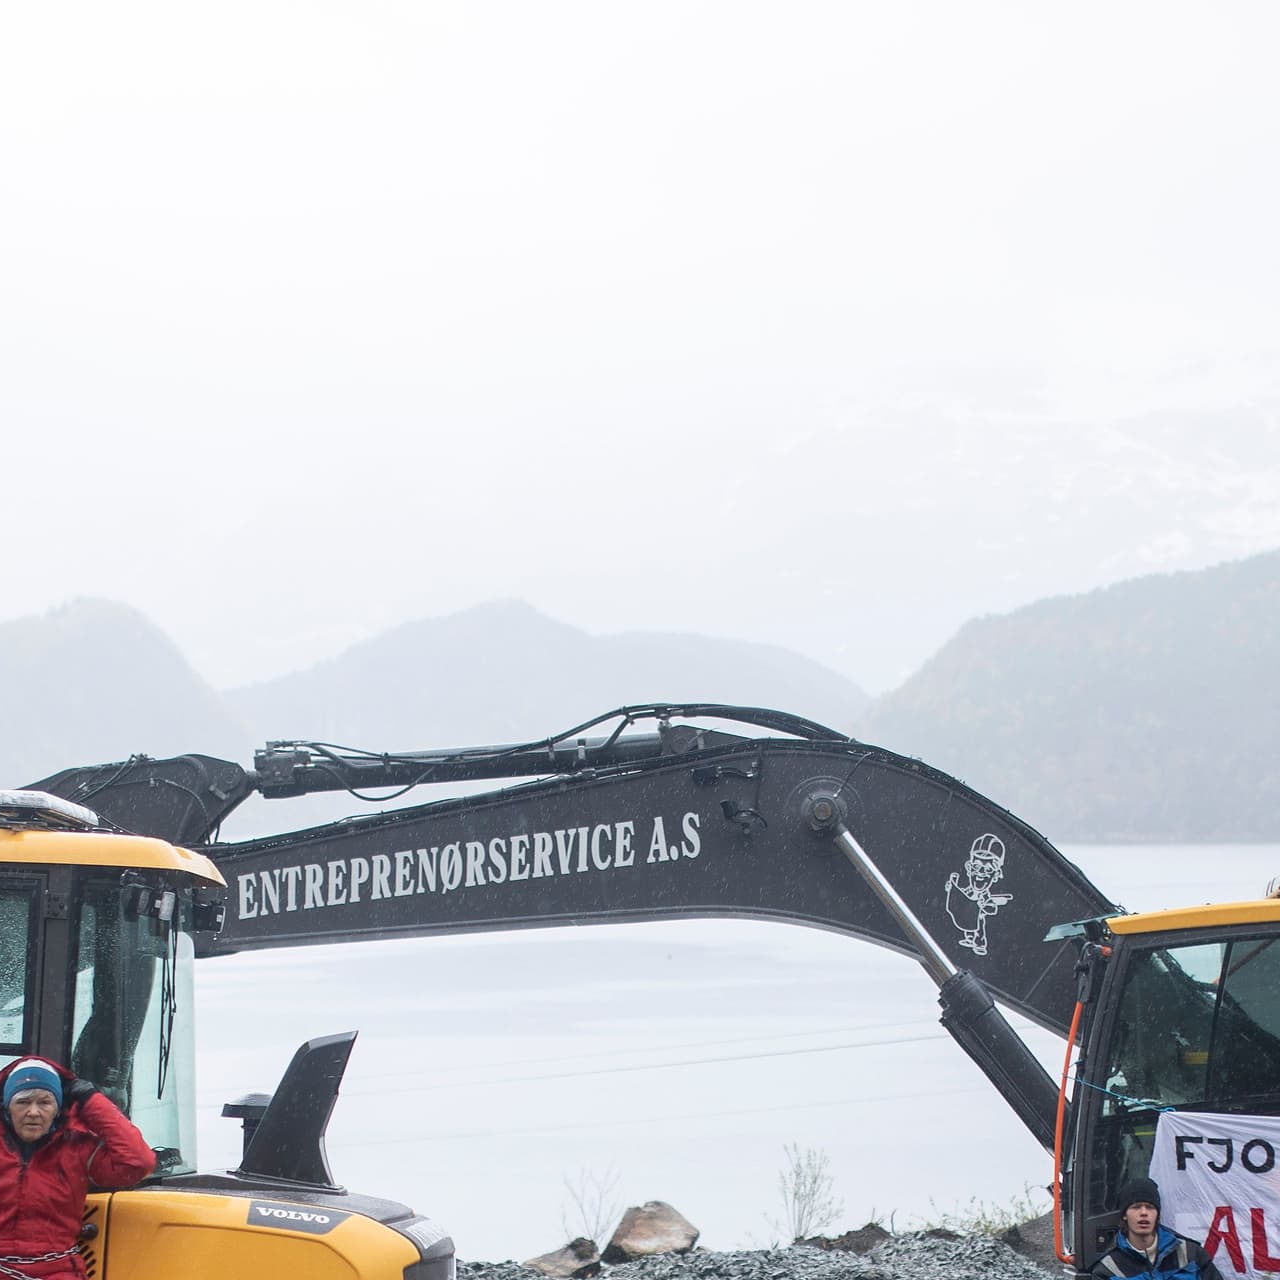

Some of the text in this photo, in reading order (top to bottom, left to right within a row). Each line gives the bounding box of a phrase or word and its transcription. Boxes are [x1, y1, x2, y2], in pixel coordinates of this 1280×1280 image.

[237, 811, 702, 920] ENTREPRENØRSERVICE A.S
[255, 1206, 331, 1225] VOLVO
